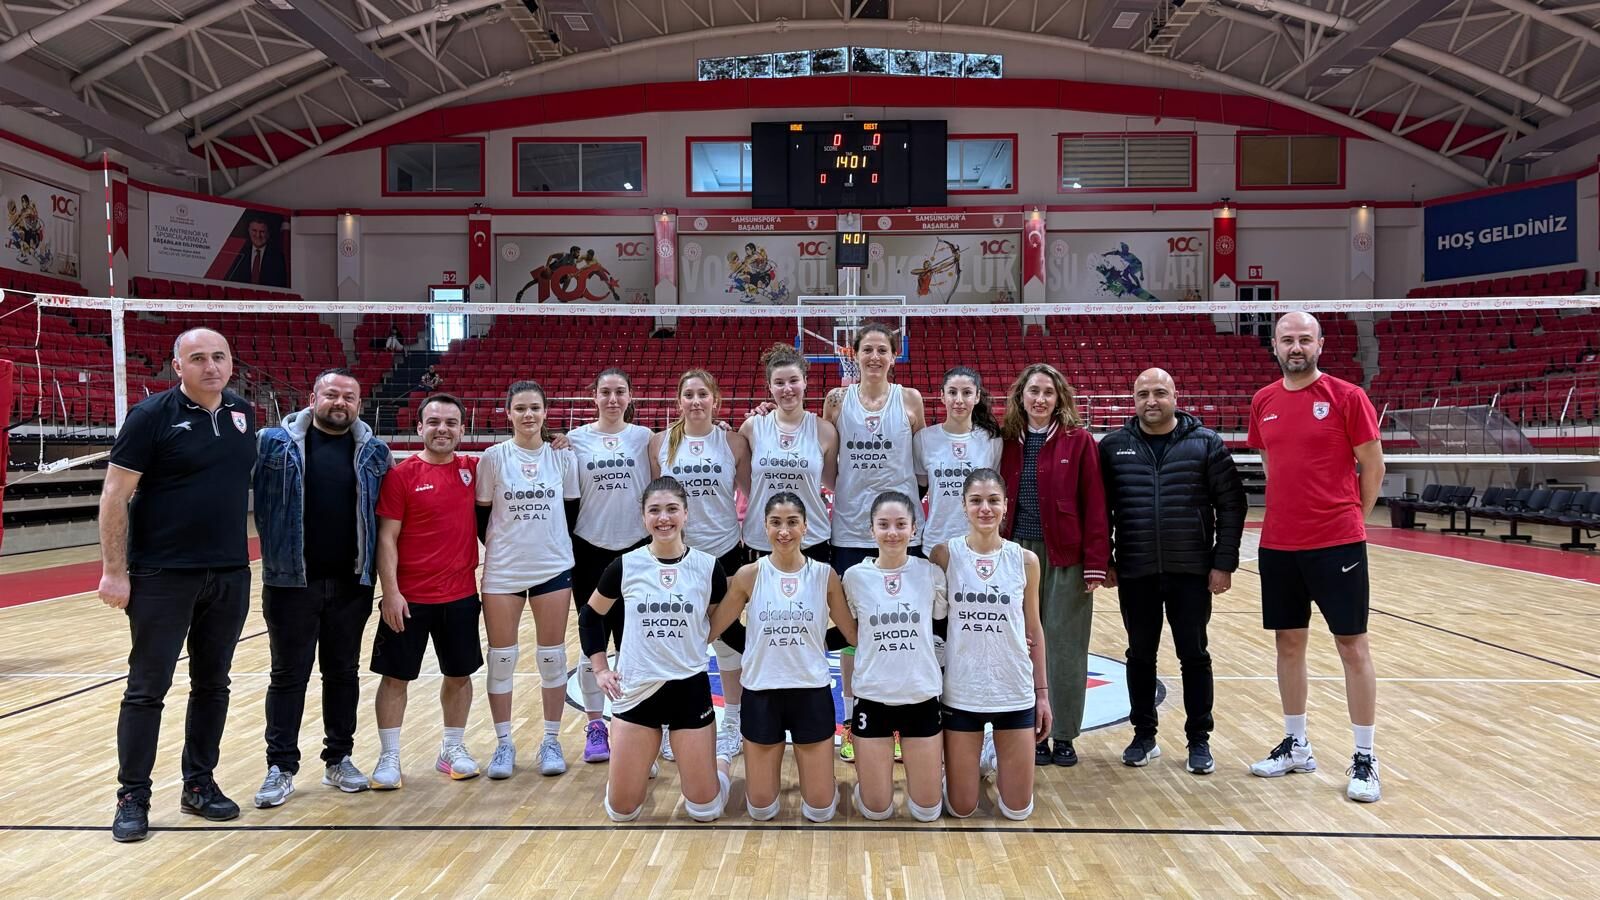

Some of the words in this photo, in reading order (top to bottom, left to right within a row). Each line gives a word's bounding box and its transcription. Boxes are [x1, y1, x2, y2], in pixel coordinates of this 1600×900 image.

[834, 134, 841, 146] 0
[873, 134, 880, 145] 0
[820, 174, 826, 183] 0
[872, 174, 877, 183] 0
[1437, 231, 1474, 250] HOŞ
[1478, 215, 1567, 244] GELDİNİZ
[1249, 268, 1262, 277] B1
[954, 583, 1010, 605] diadora
[637, 594, 693, 614] diadora
[759, 601, 814, 622] diadora
[870, 602, 920, 627] diadora
[646, 630, 683, 638] ASAL
[962, 624, 1002, 633] ASAL
[769, 638, 805, 647] ASAL
[879, 643, 915, 652] ASAL
[858, 712, 867, 730] 3
